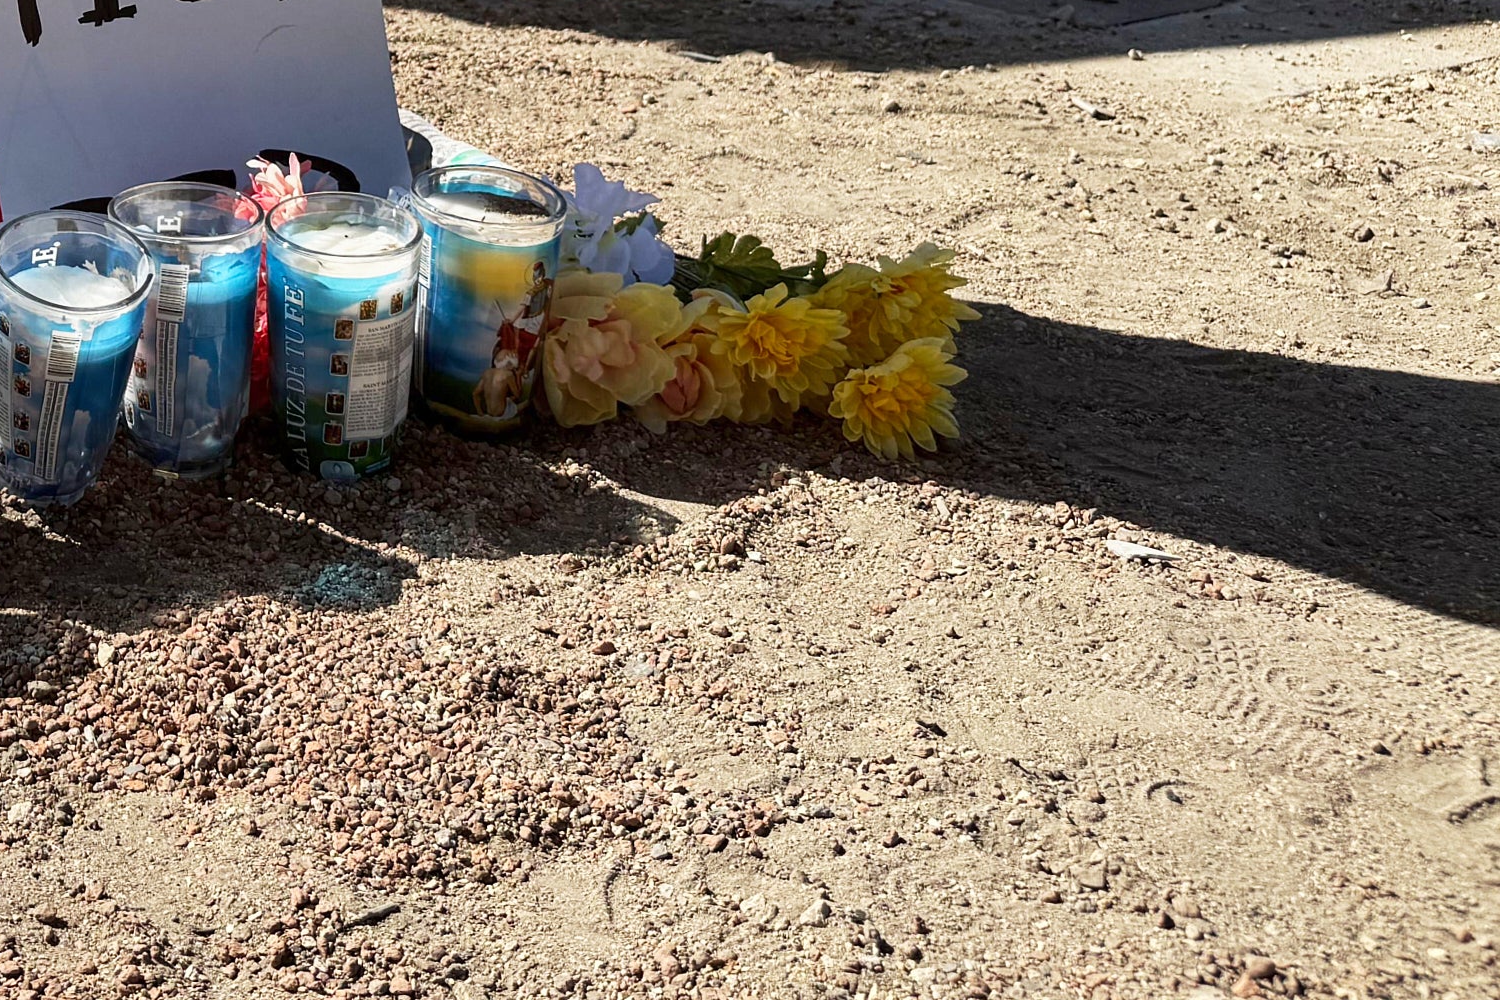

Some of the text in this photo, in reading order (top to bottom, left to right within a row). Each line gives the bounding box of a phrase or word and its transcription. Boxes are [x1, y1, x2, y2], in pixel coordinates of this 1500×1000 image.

[156, 210, 184, 232] E.
[285, 325, 306, 357] TU
[286, 362, 306, 395] DE
[286, 397, 307, 443] LUZ
[292, 446, 310, 471] LA
